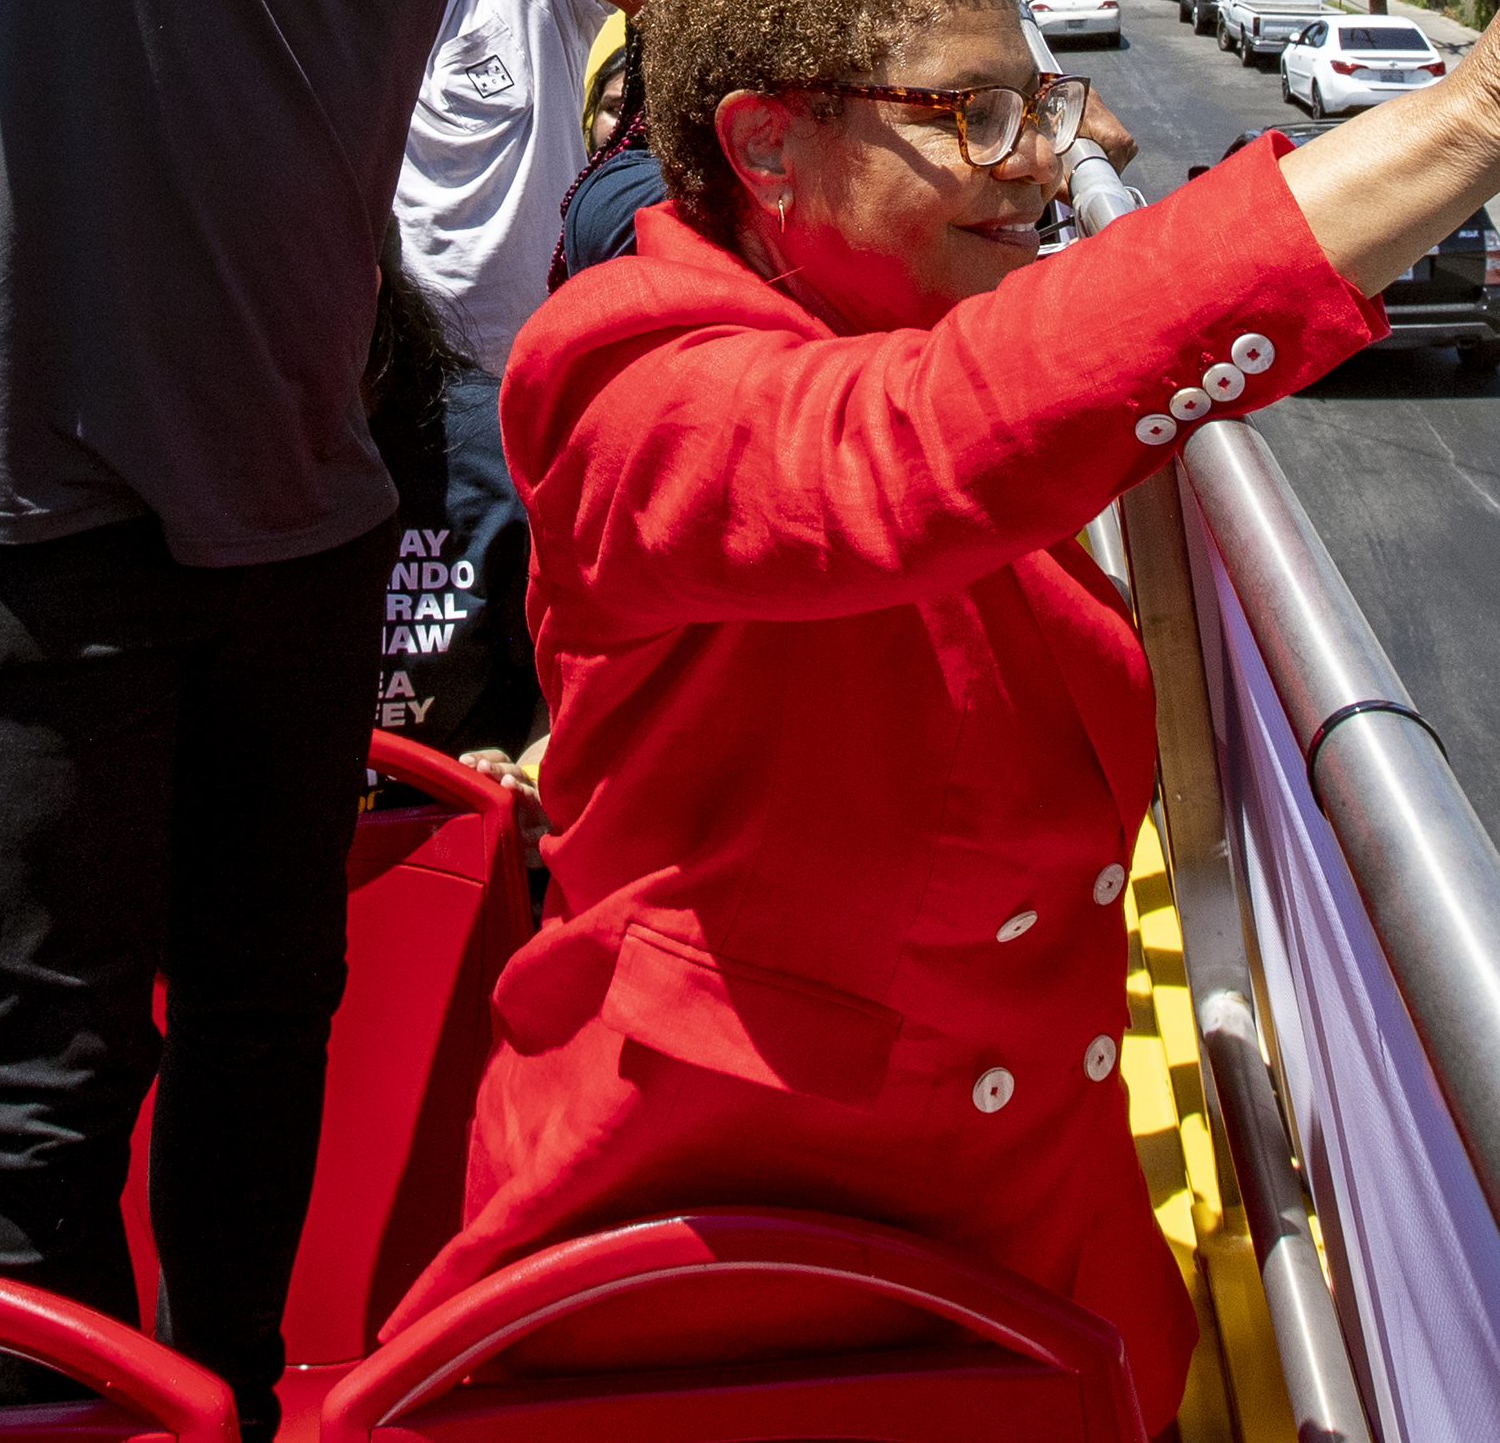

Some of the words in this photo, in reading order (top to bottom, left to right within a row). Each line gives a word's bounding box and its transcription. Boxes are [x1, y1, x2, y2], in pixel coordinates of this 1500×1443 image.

[400, 529, 450, 557] AY
[387, 560, 475, 590] NDO
[386, 593, 467, 621] RAL
[382, 623, 455, 655] AW
[375, 697, 435, 727] EY
